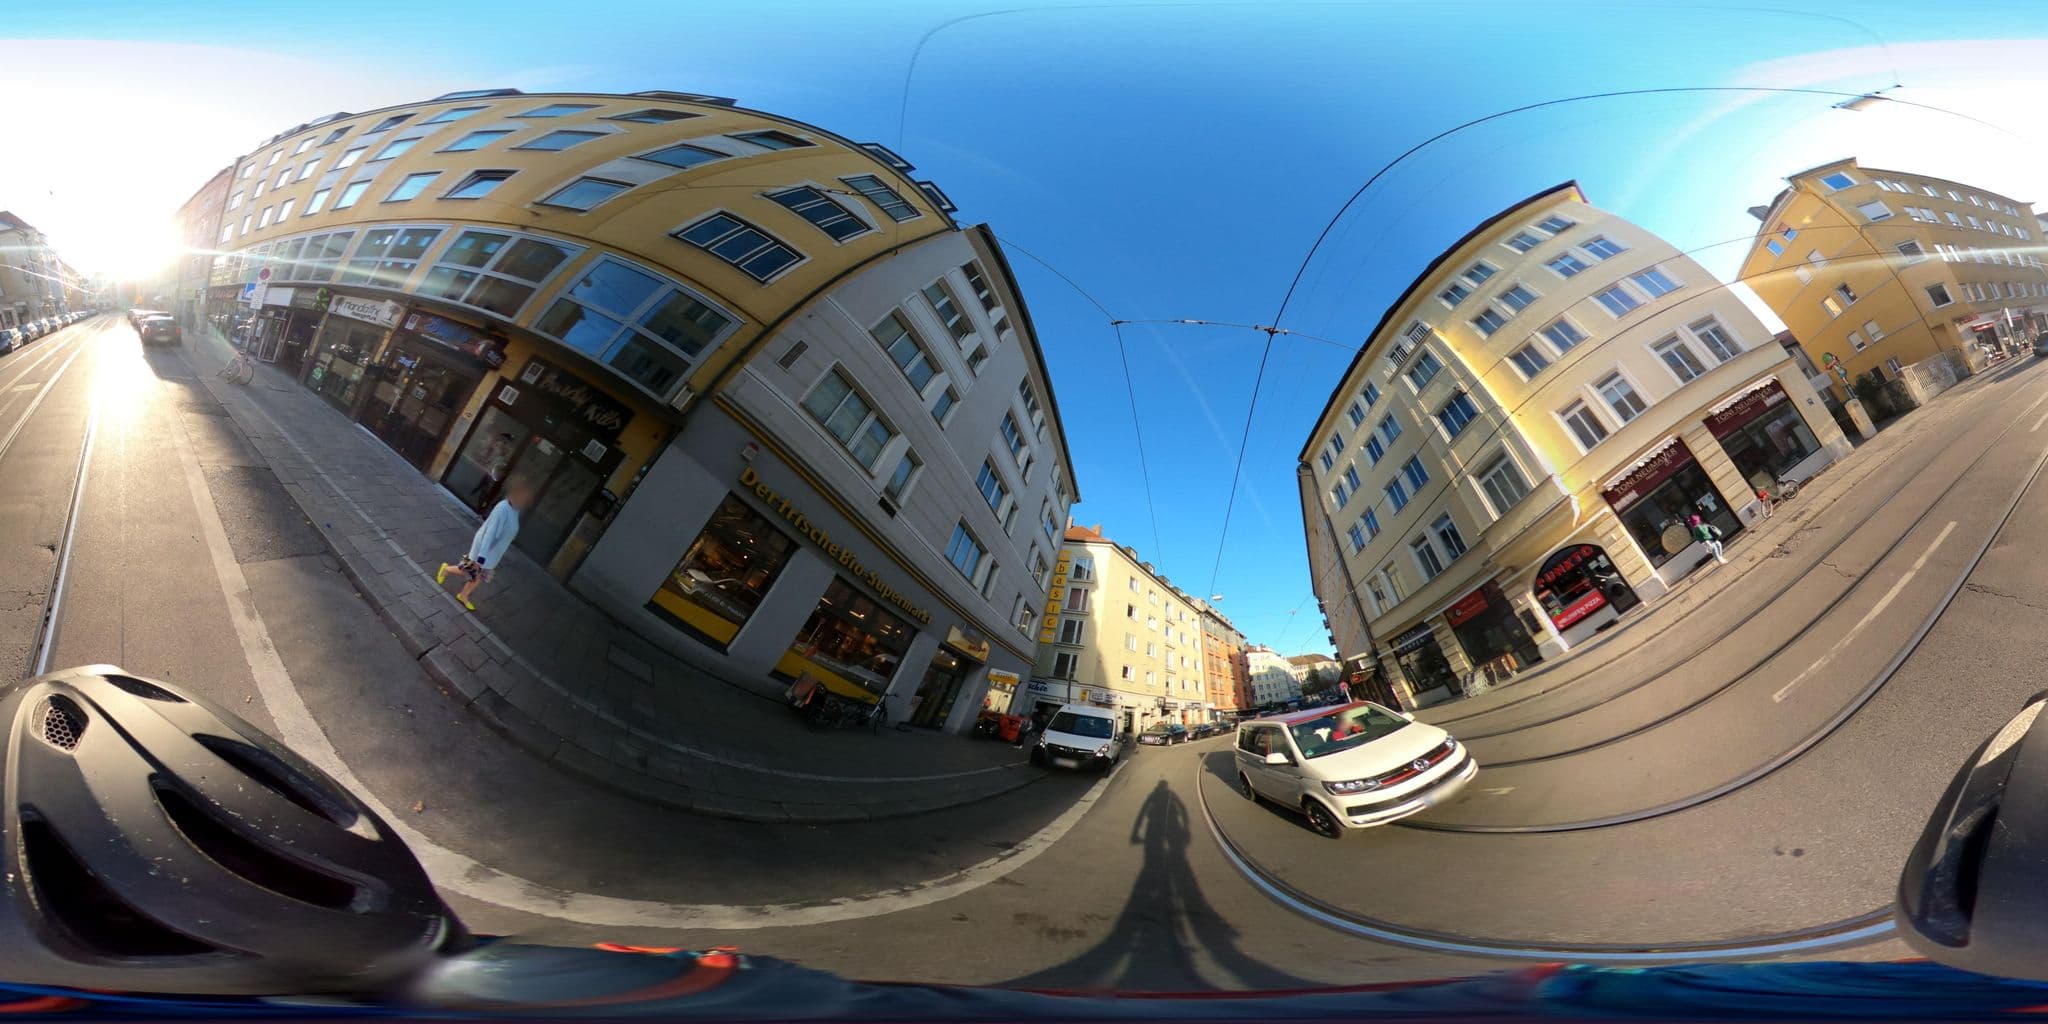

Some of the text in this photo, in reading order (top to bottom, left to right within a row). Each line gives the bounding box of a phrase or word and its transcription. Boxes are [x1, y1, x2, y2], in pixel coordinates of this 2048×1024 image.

[1714, 386, 1773, 424] TONI NEUMAYER
[1614, 480, 1633, 495] TONI
[1634, 447, 1677, 482] NEUMAYER
[740, 466, 933, 625] Der frische Bio-Supermarkt
[1536, 545, 1594, 588] PUNKTO
[1046, 561, 1067, 627] basic
[1584, 597, 1601, 609] PIZZA
